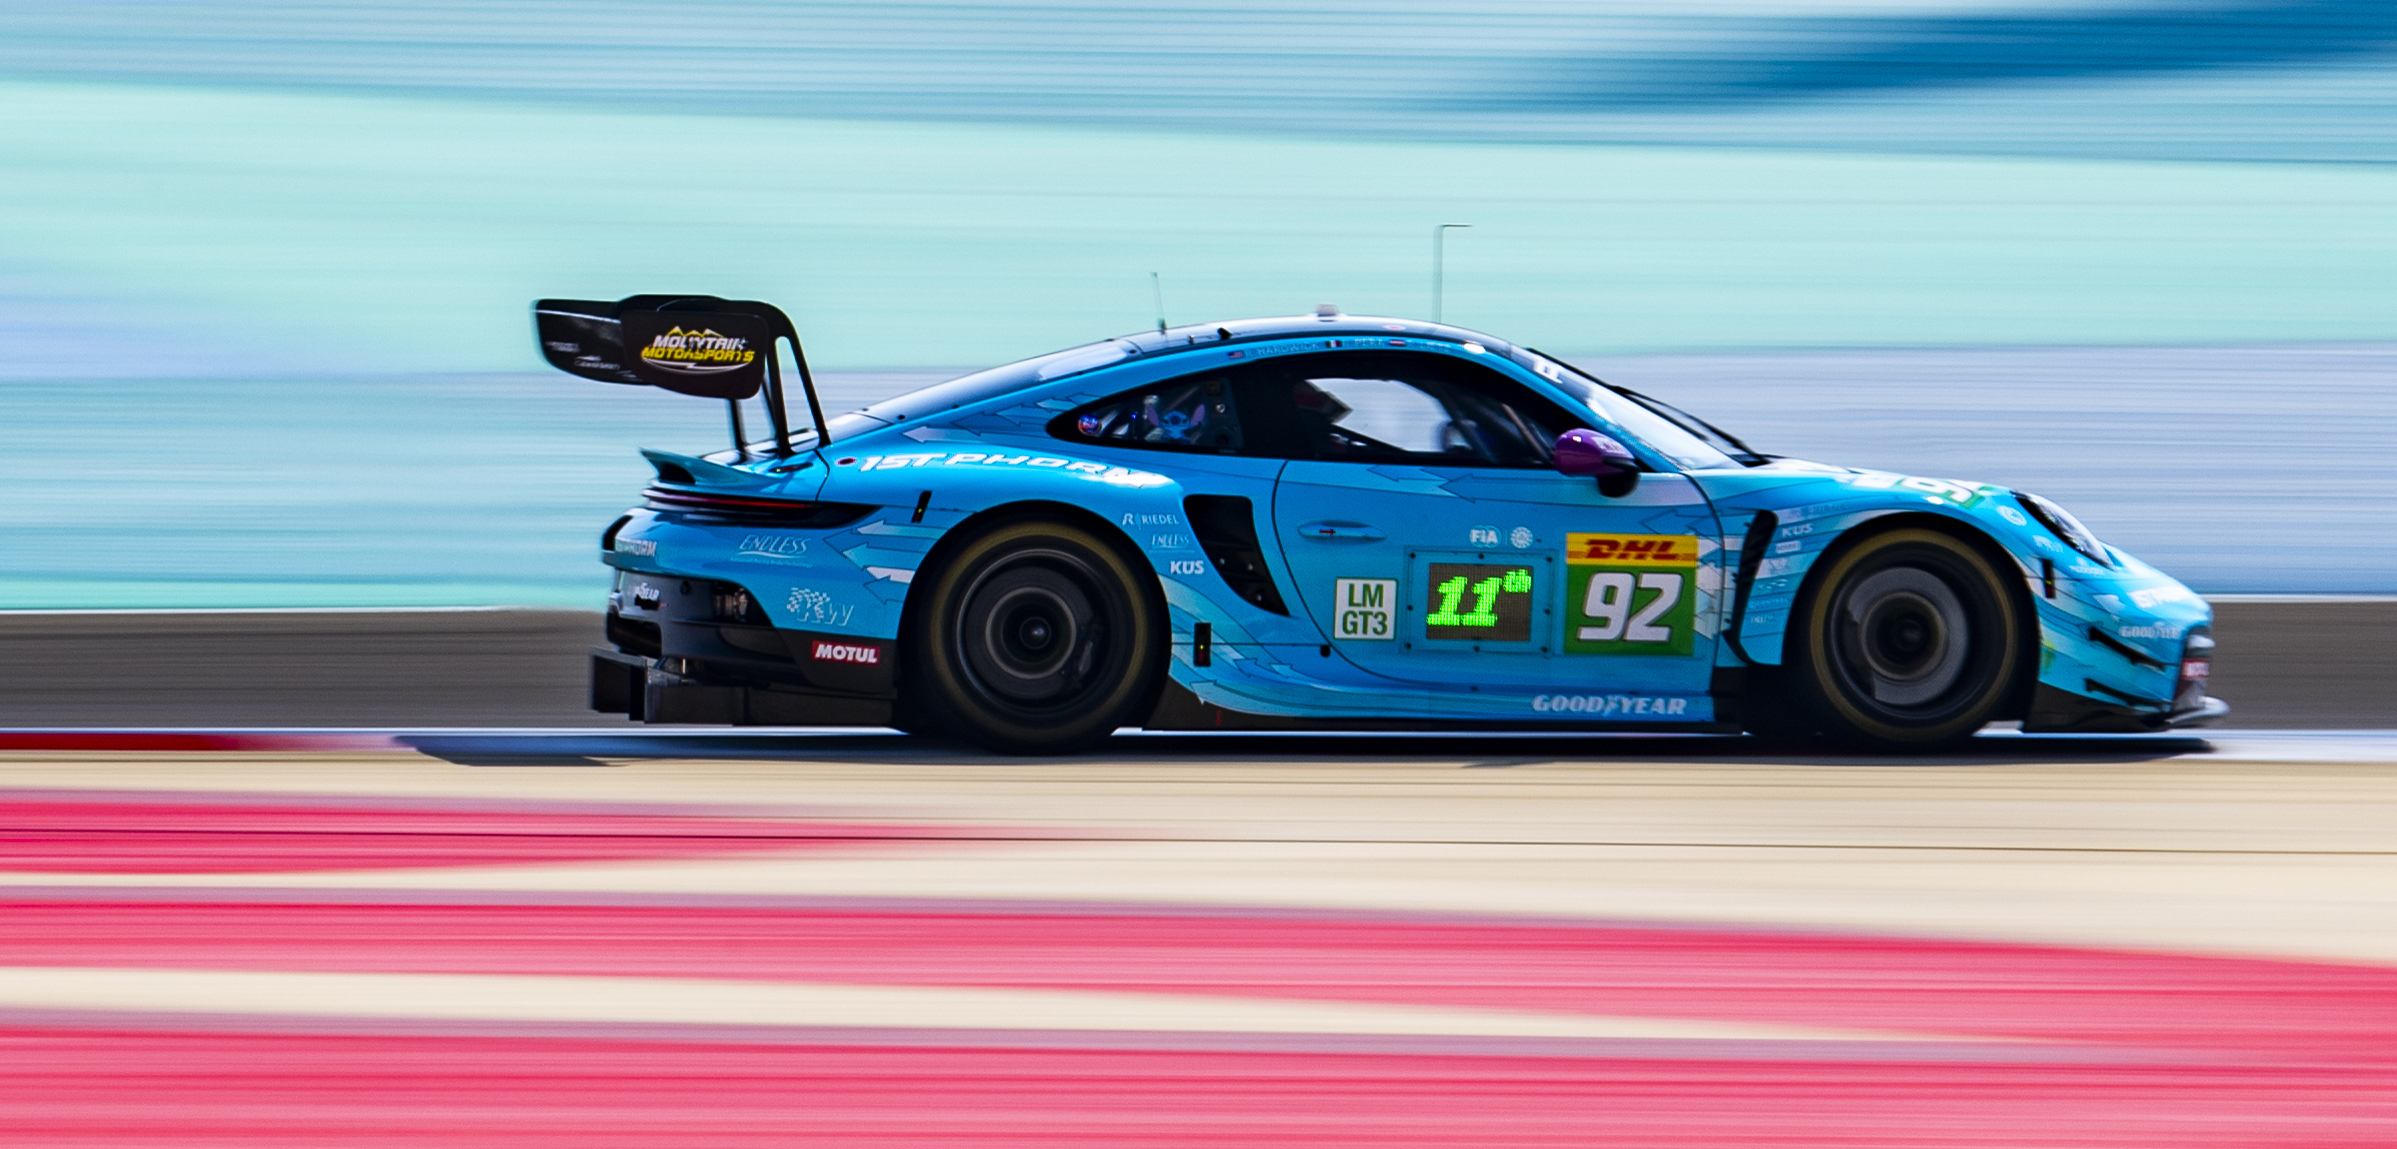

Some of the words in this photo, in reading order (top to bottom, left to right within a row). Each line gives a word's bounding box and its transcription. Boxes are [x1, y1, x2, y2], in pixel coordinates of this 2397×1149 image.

[641, 346, 755, 362] MOTORSPORTS
[860, 453, 948, 472] 1ST
[943, 453, 1166, 488] PHORM
[1141, 513, 1180, 526] RIEDEL
[739, 534, 811, 555] ENDLESS
[1470, 528, 1499, 544] FIA
[1585, 538, 1681, 561] DHL
[1348, 583, 1384, 608] LM
[1577, 571, 1684, 642] 92
[1342, 610, 1388, 635] GT3
[814, 643, 878, 664] MOTUL
[1532, 694, 1687, 717] GOODYEAR
